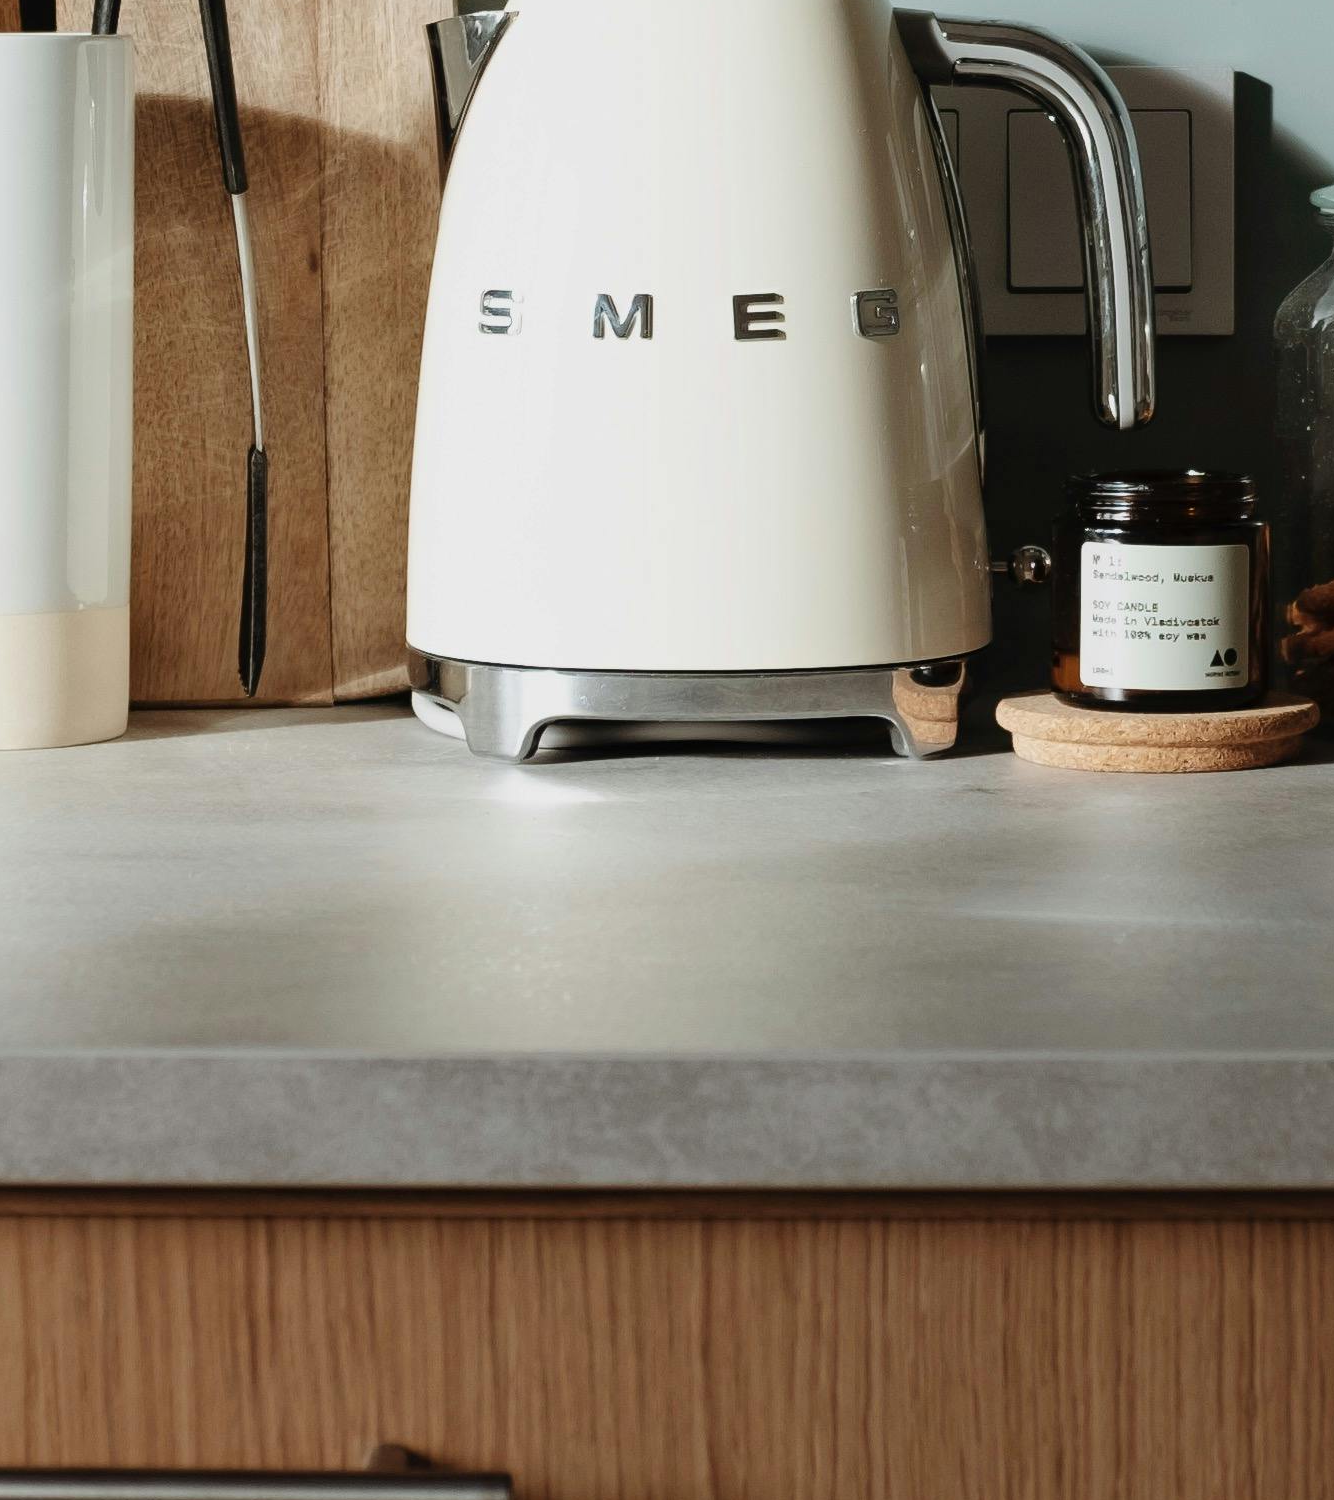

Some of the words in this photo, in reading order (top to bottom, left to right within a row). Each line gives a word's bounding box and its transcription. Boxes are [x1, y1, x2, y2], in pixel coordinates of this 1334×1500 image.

[478, 287, 902, 342] SMEG
[1092, 568, 1165, 585] Sandalwood,
[1092, 599, 1112, 610] SOY
[1117, 601, 1159, 613] CANDLE
[1092, 613, 1117, 625] Made
[1124, 616, 1138, 626] in
[1143, 615, 1220, 627] Vladivostok
[1092, 627, 1117, 638] with
[1125, 629, 1152, 640] 100%
[1158, 632, 1180, 643] soy
[1186, 632, 1207, 641] wax
